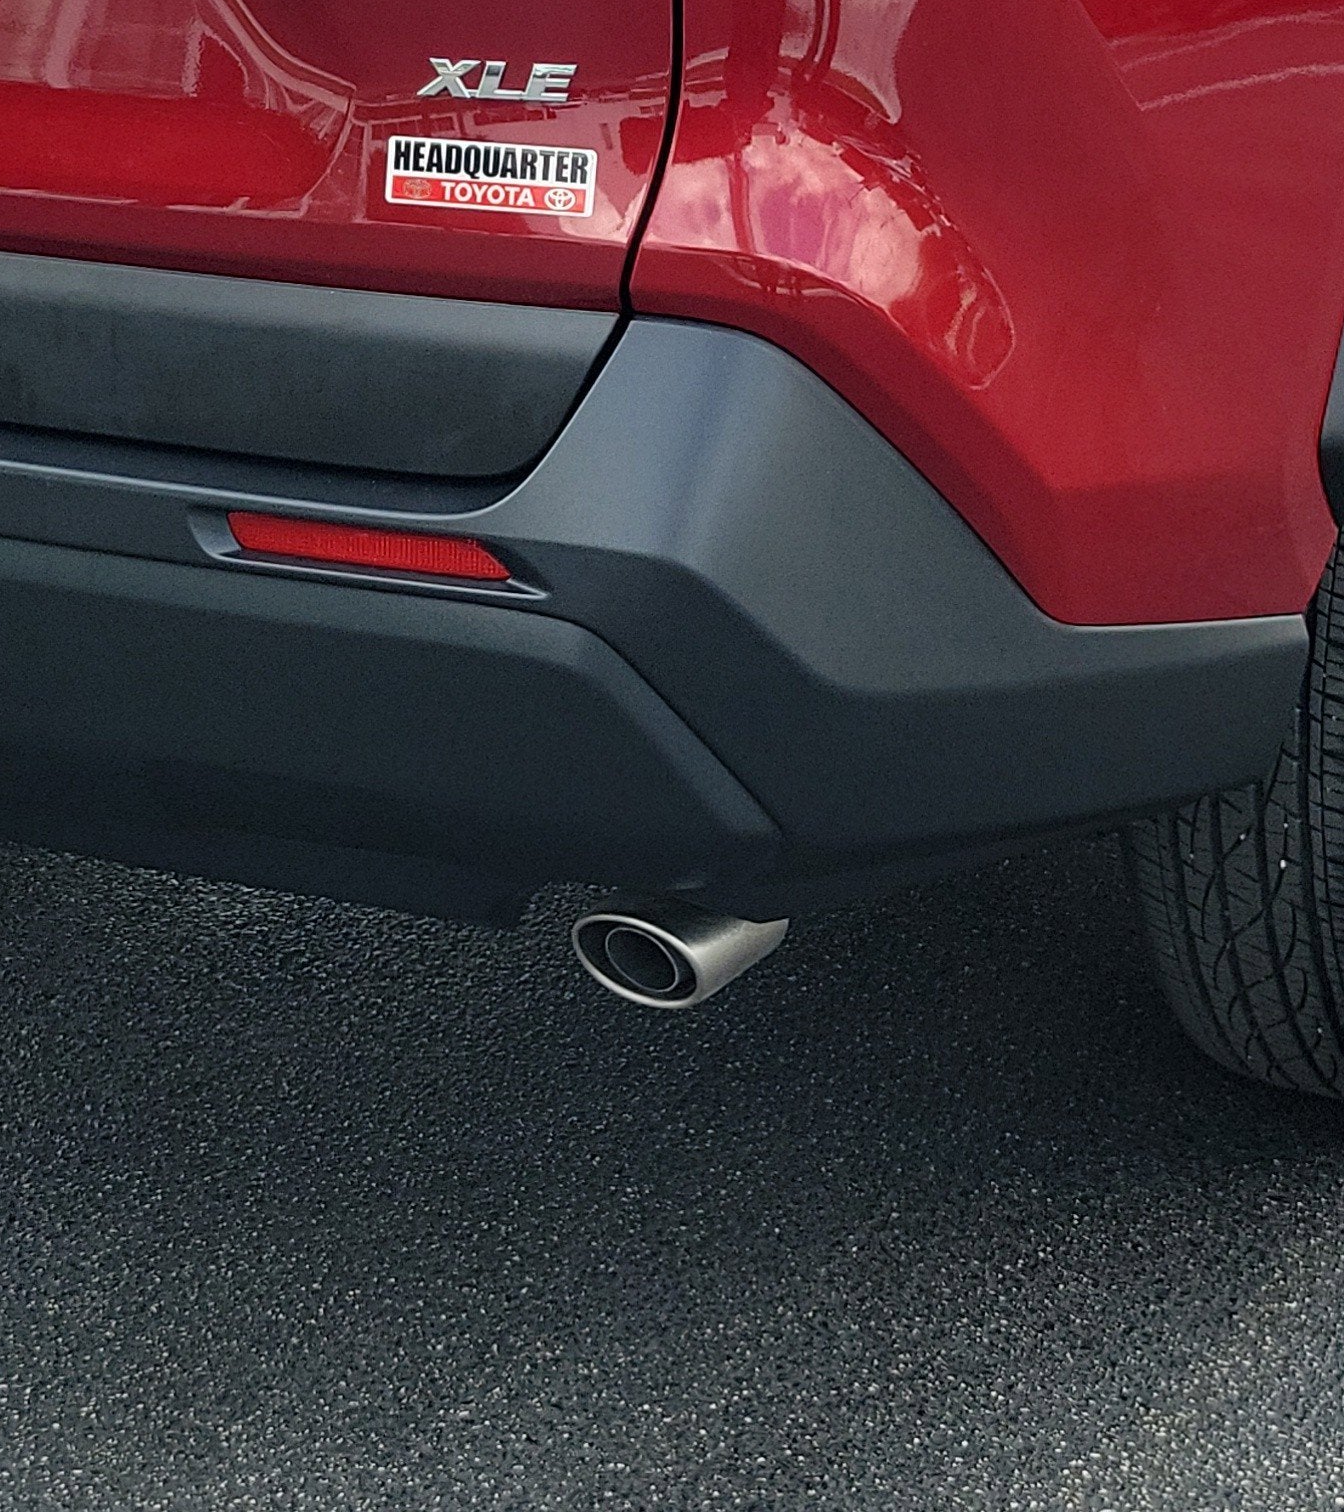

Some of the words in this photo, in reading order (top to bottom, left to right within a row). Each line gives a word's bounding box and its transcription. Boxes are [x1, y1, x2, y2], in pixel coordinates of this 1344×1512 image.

[417, 57, 578, 102] XLE
[393, 139, 588, 184] HEADQUARTER
[442, 182, 535, 207] TOYOTA
